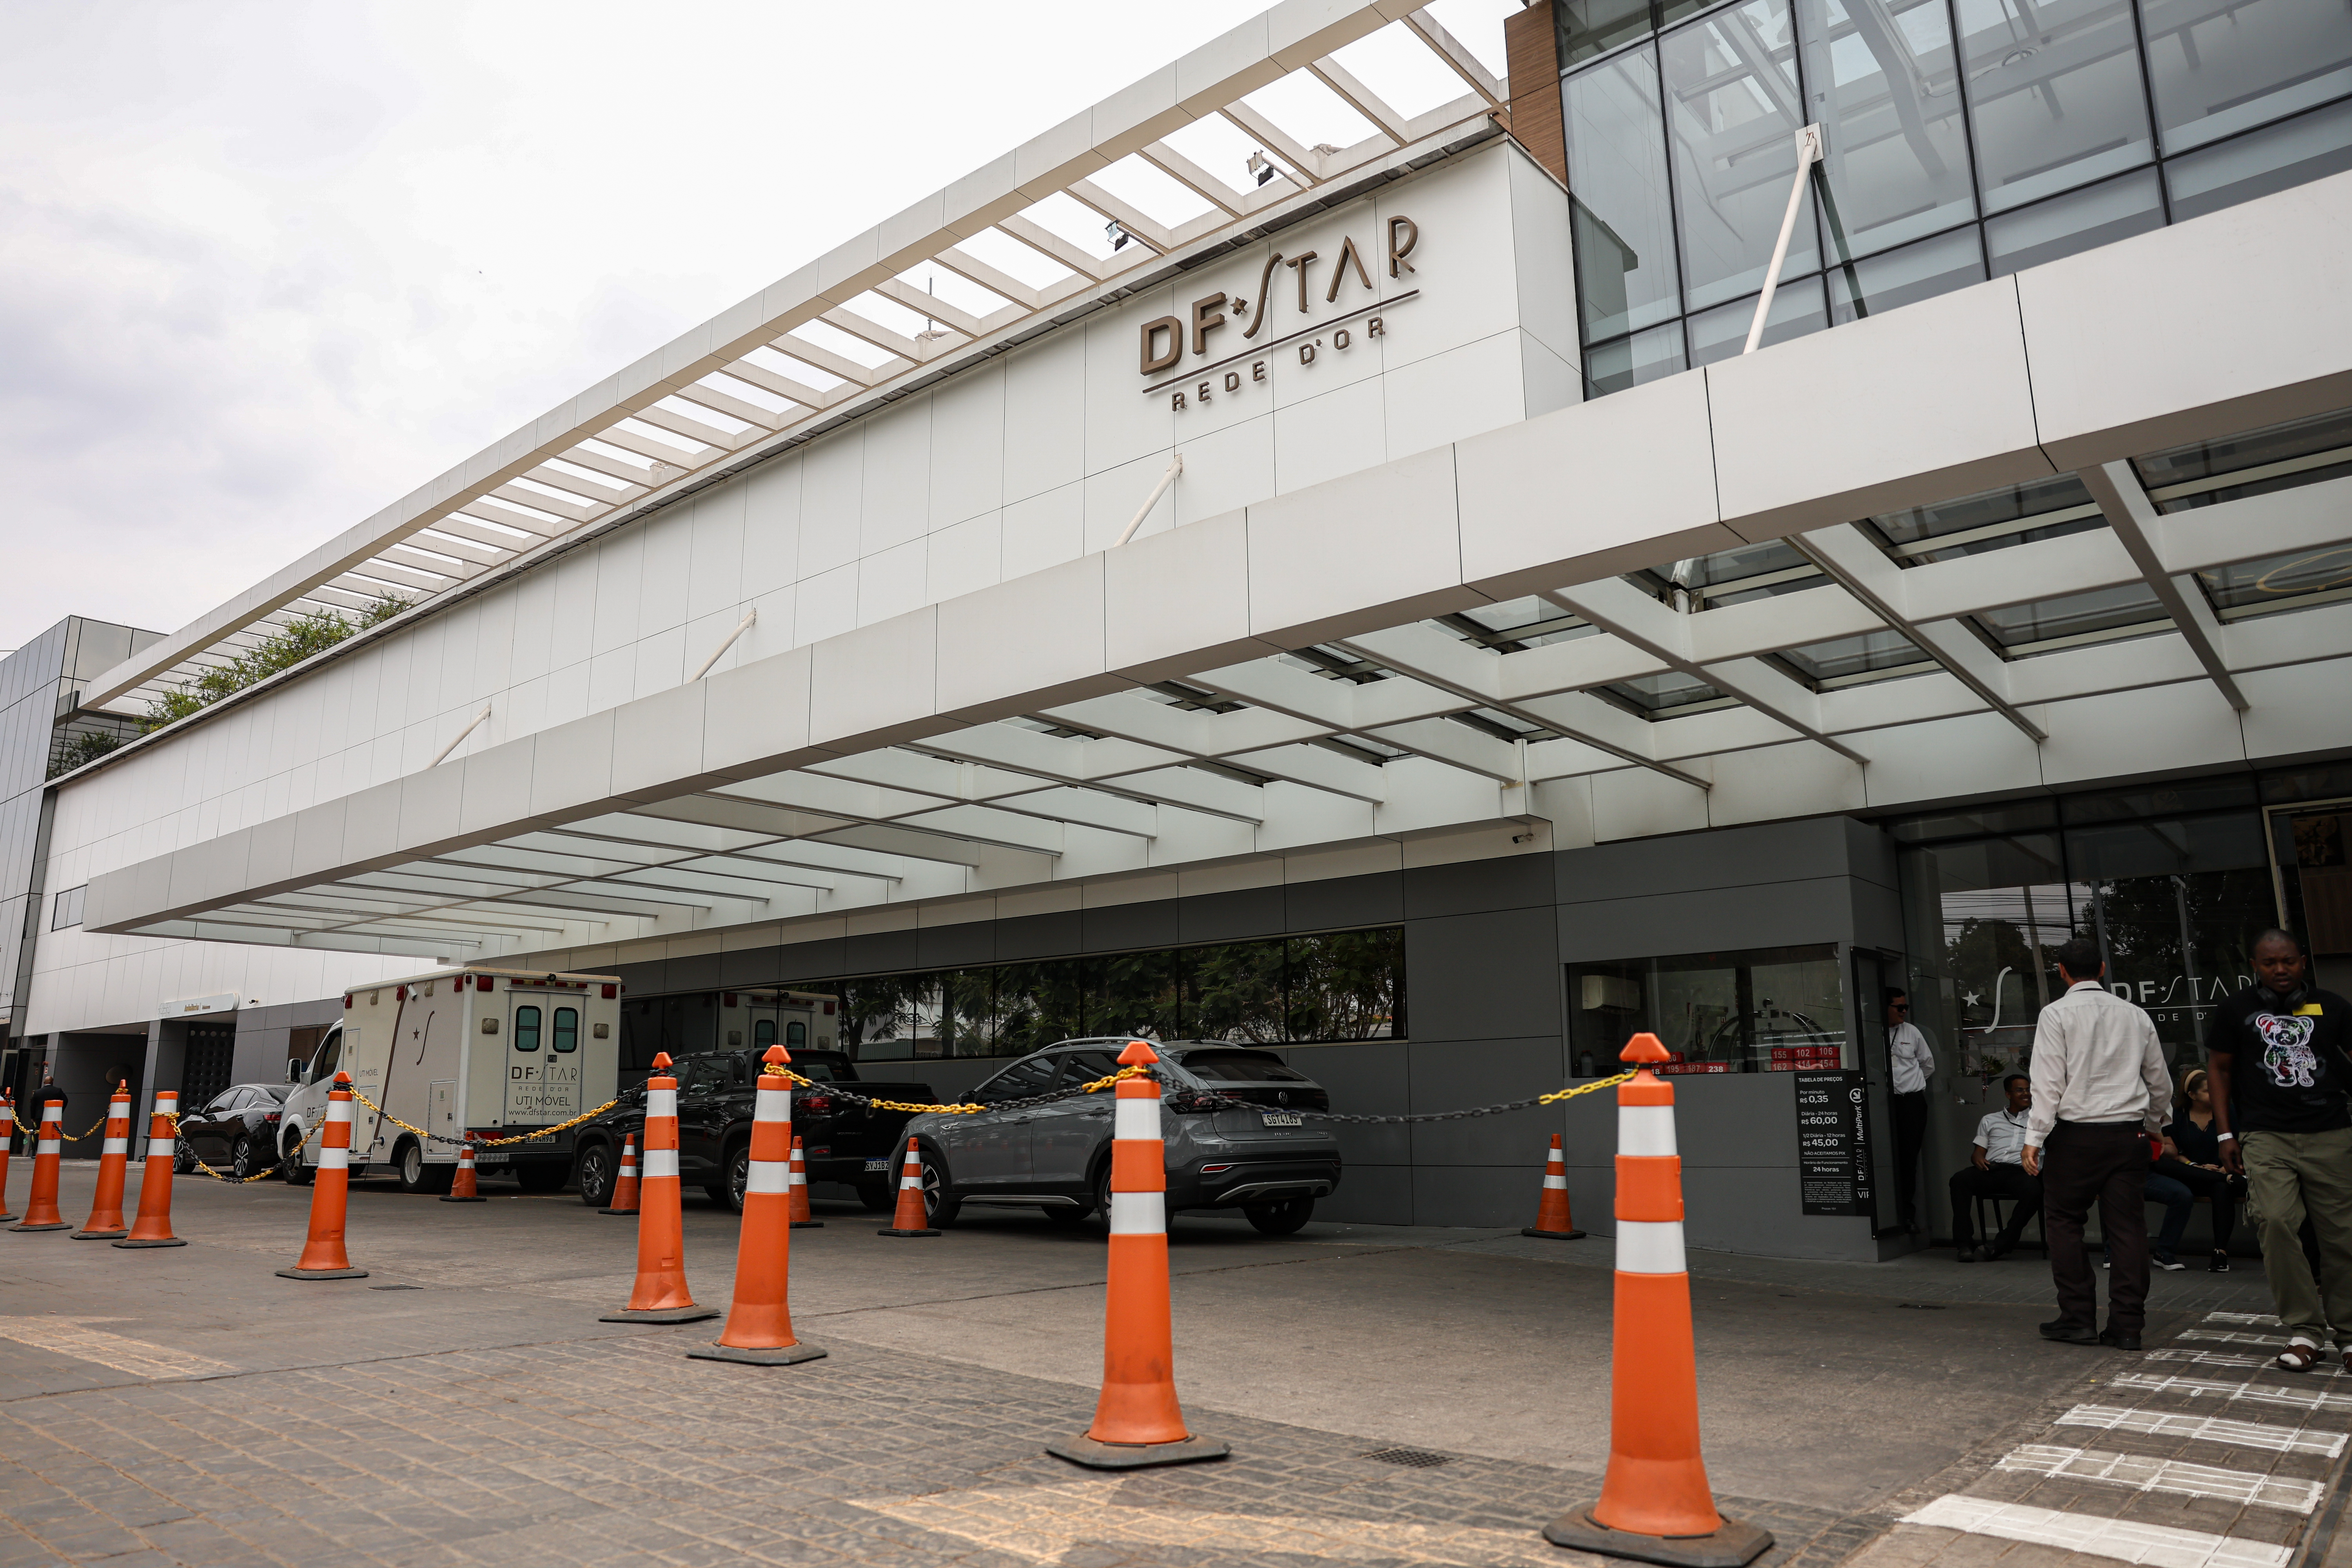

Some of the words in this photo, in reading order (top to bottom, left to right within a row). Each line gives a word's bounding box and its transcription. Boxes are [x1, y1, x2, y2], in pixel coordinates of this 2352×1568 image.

[1172, 360, 1266, 412] REDE
[1299, 317, 1384, 365] D'OR
[1797, 1060, 1811, 1069] 114
[366, 1068, 378, 1076] MÓVEL
[516, 1096, 532, 1105] UTI
[535, 1094, 570, 1106] MÓVEL
[1809, 1095, 1828, 1104] 0,35
[1810, 1117, 1837, 1125] 60,00
[1812, 1139, 1838, 1147] 45,00
[866, 1161, 889, 1170] SYJ1B2
